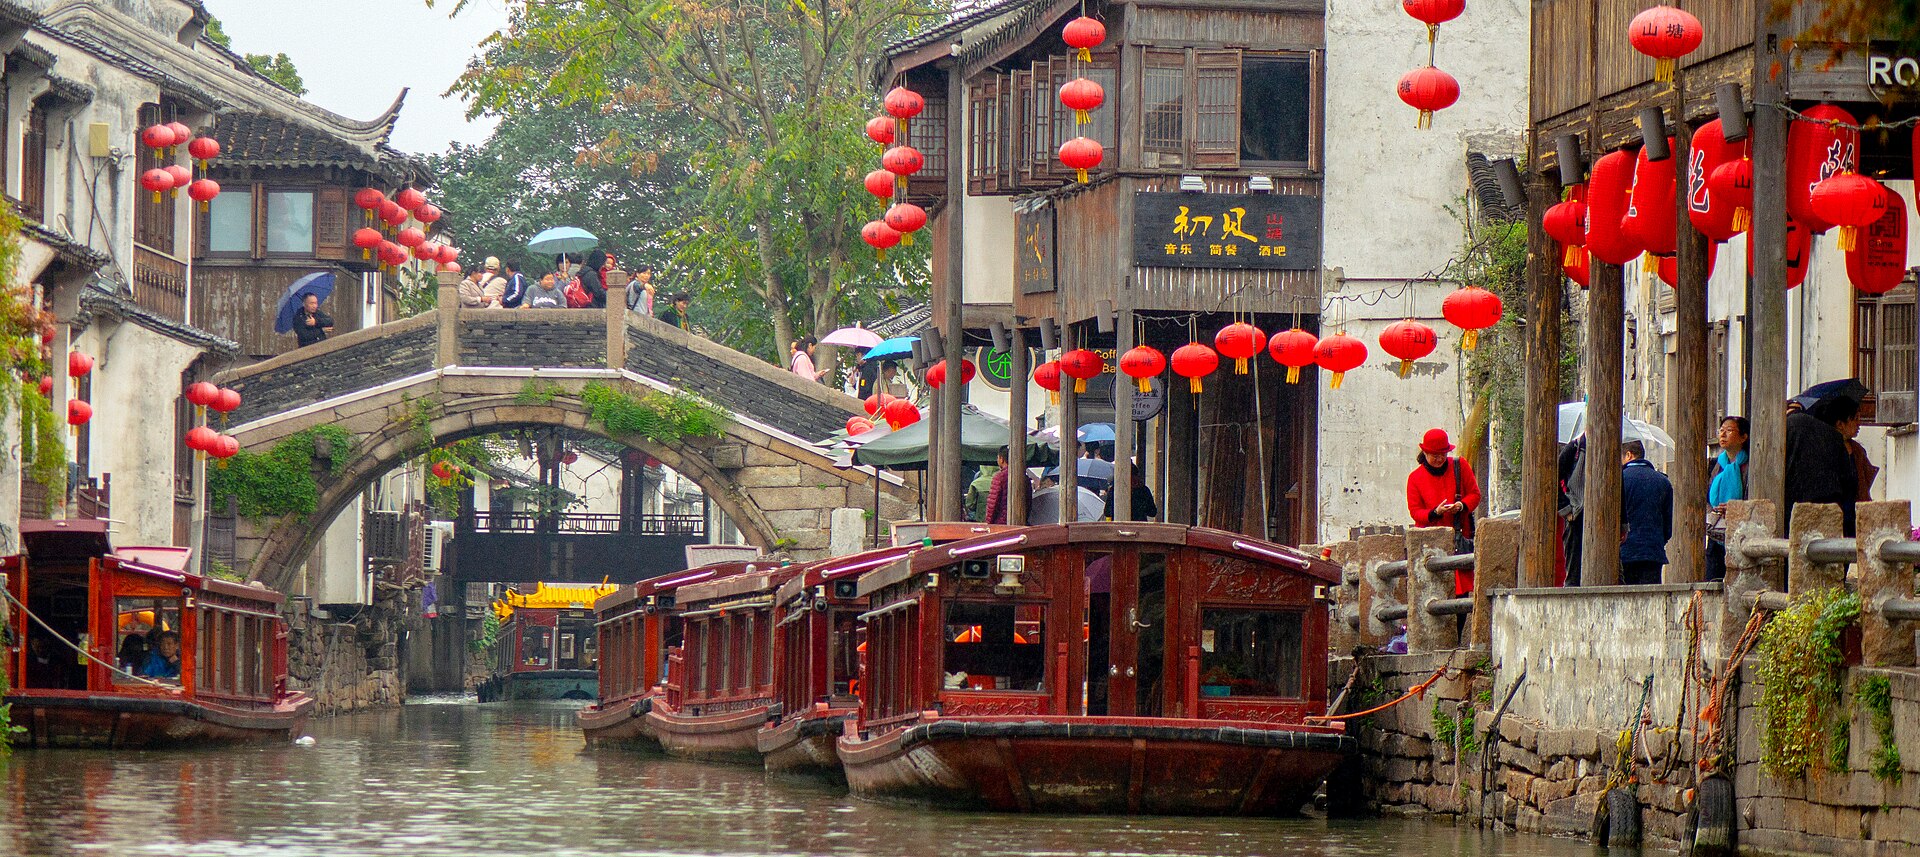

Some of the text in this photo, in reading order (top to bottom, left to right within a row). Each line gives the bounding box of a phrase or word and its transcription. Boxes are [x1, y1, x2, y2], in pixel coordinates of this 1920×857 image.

[1642, 22, 1685, 39] 山塘
[1173, 205, 1258, 244] 初见
[1164, 244, 1287, 257] 音乐 简餐 酒吧
[1095, 349, 1117, 360] Coff
[1103, 362, 1116, 374] Ba
